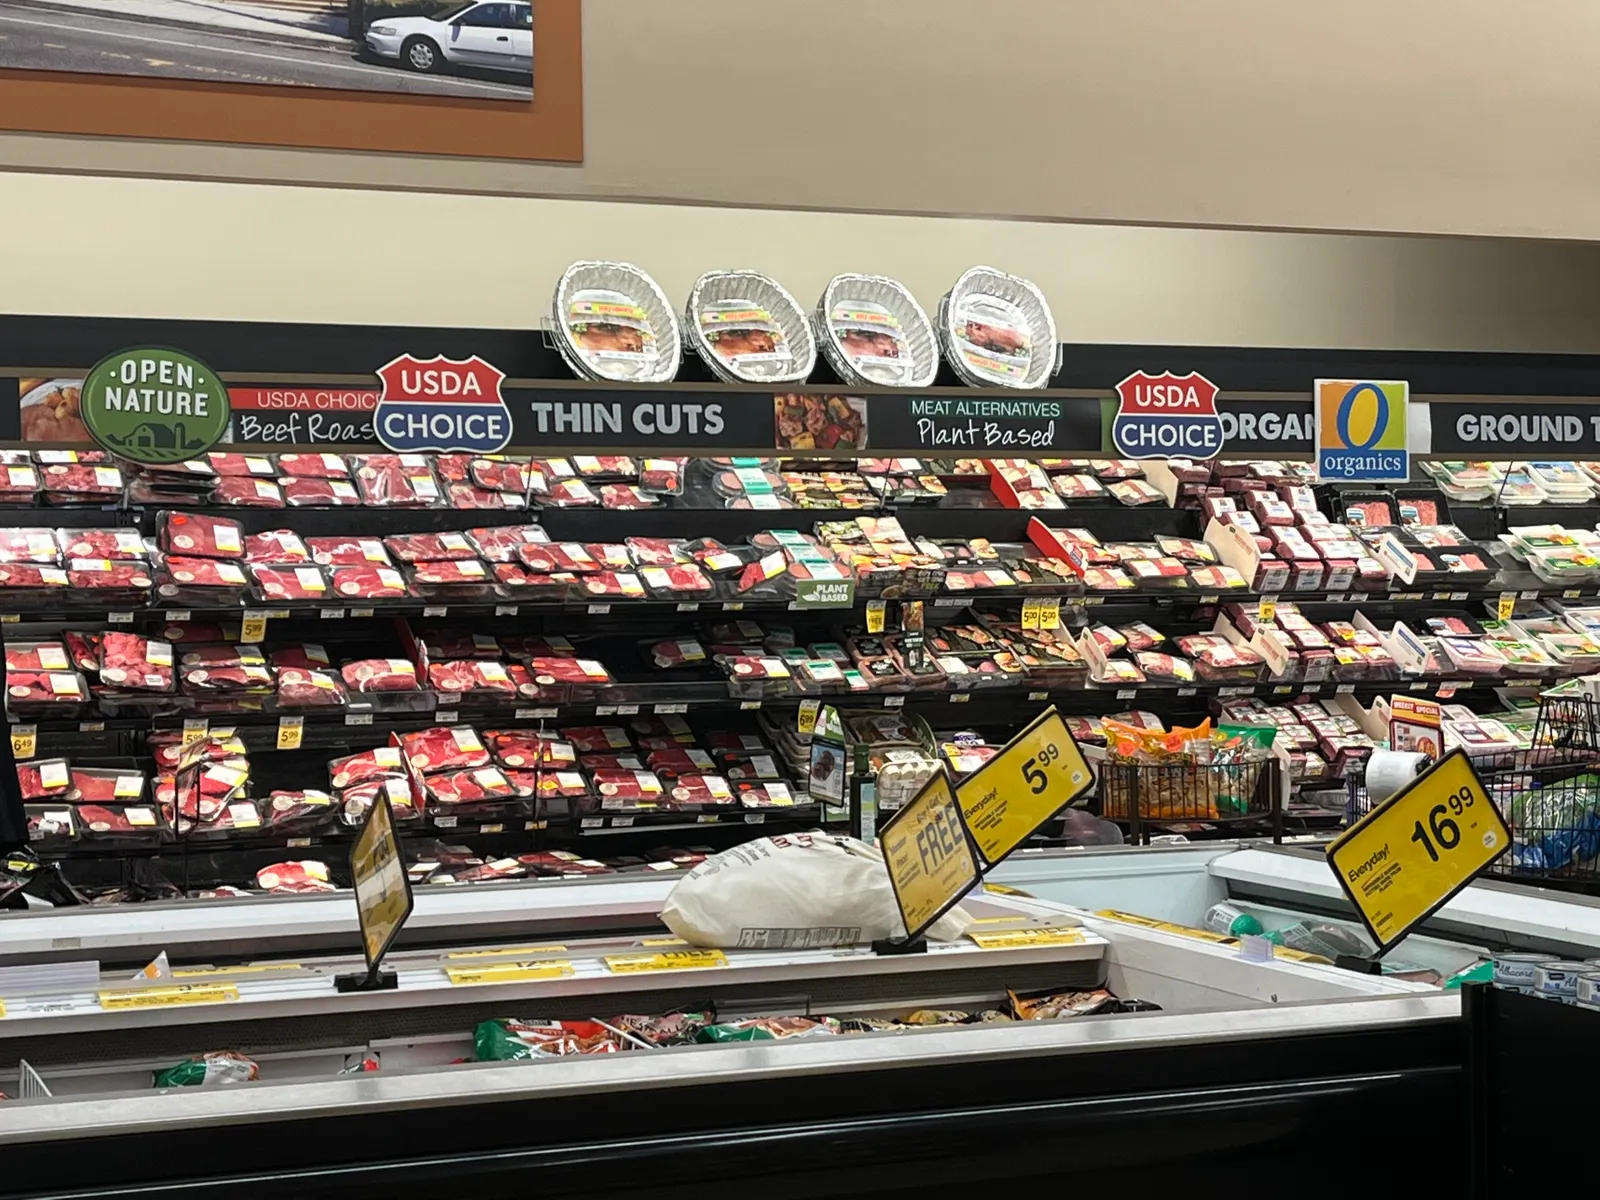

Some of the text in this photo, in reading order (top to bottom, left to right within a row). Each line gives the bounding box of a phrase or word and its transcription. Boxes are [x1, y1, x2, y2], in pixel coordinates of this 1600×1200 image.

[119, 359, 194, 389] OPEN
[401, 370, 483, 397] USDA
[105, 387, 209, 417] NATURE
[257, 391, 310, 409] USDA
[911, 401, 1061, 418] MEAT ALTERNATIVES
[1135, 385, 1201, 408] USDA
[240, 413, 299, 442] Beef
[384, 413, 504, 440] CHOICE
[531, 402, 725, 435] THIN CUTS
[1456, 413, 1584, 442] GROUND
[917, 418, 1055, 447] Plant Based
[1120, 423, 1217, 448] CHOICE
[1324, 452, 1402, 477] organics
[816, 584, 849, 594] PLANT
[820, 593, 849, 602] BASED
[1393, 701, 1438, 715] WEEKLY SPECIAL
[964, 787, 998, 819] Everyday!
[916, 801, 964, 875] FREE
[1348, 843, 1390, 882] Everyday!
[1499, 964, 1534, 978] Albacore
